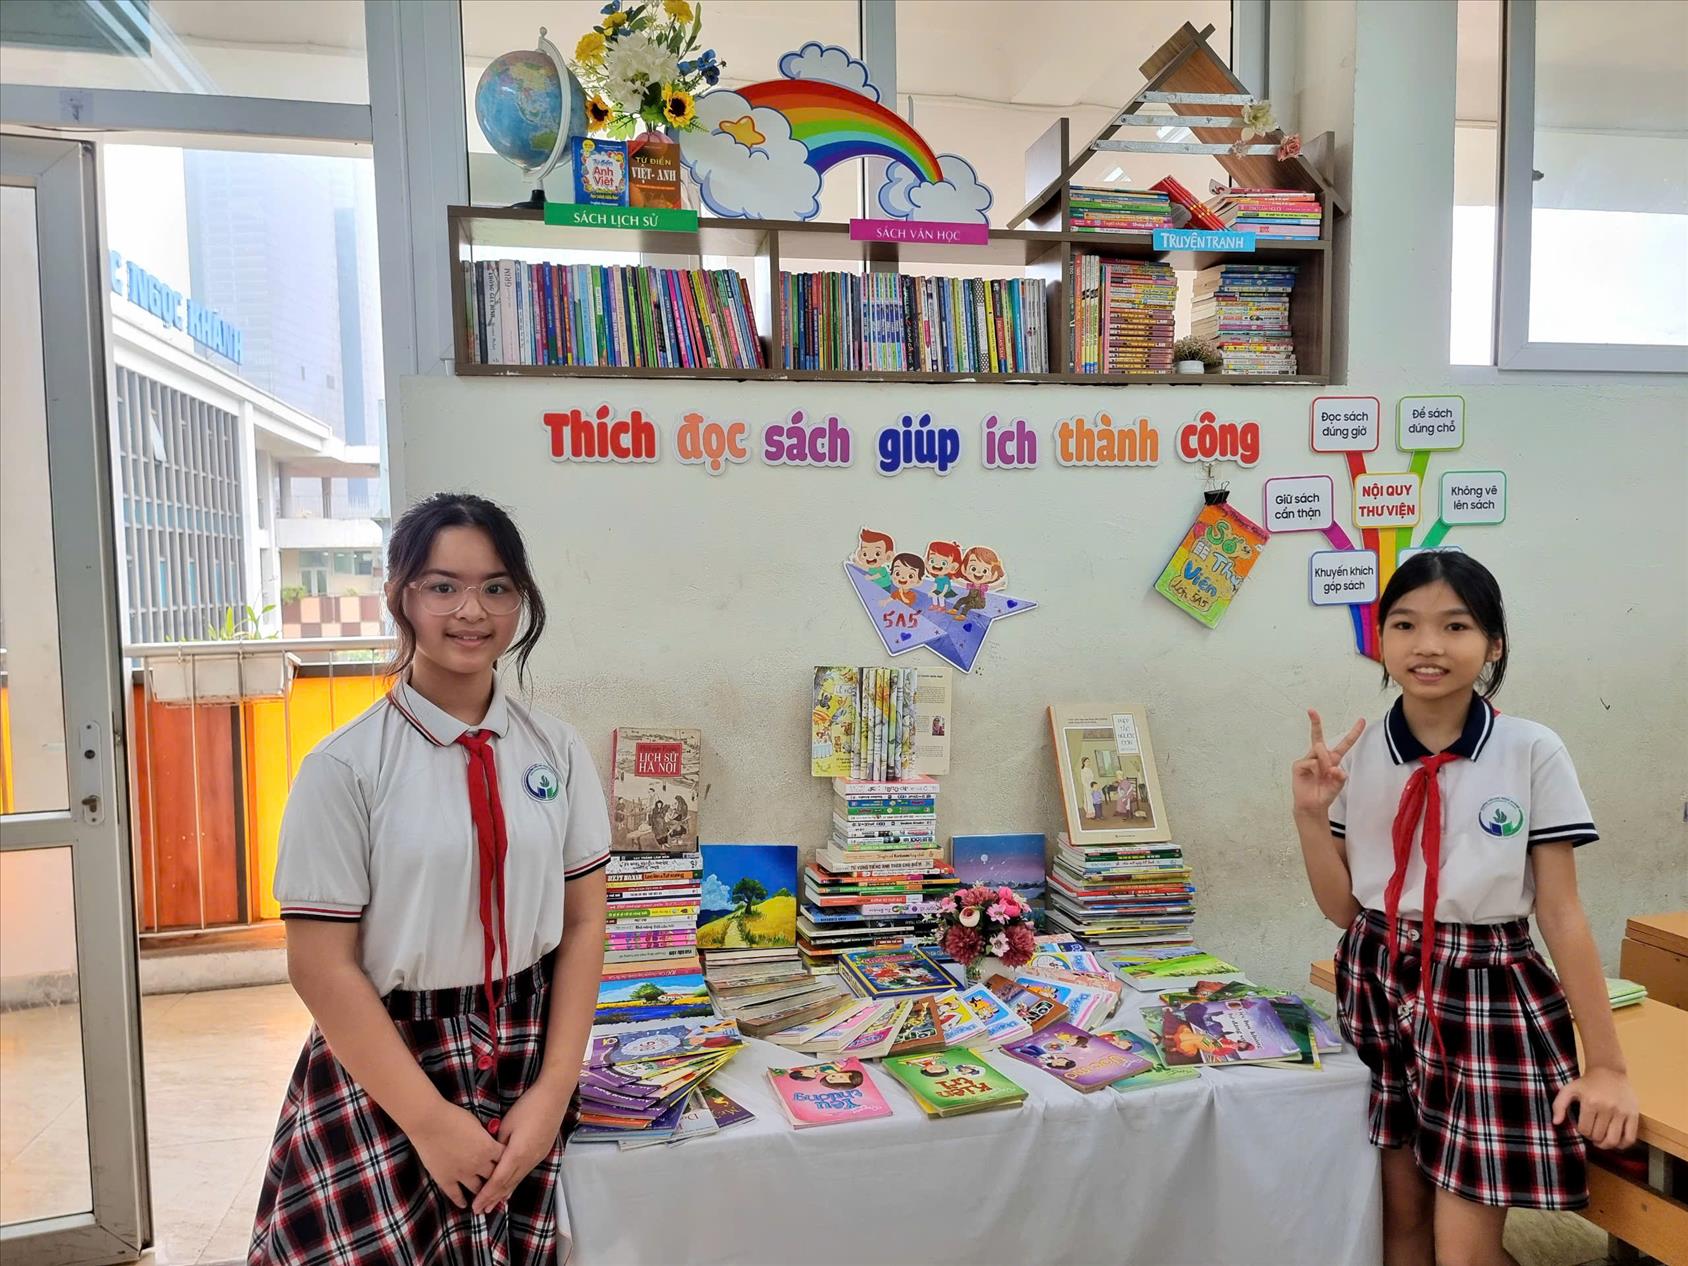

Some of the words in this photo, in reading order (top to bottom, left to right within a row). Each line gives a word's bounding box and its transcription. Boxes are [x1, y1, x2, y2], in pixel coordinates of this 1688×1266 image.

[593, 167, 614, 176] Anh
[657, 169, 676, 181] ANH
[574, 210, 607, 225] SÁCH
[611, 214, 639, 227] LỊCH
[643, 212, 659, 227] SỬ
[876, 226, 906, 239] SÁCH
[937, 230, 961, 242] HỌC
[1321, 411, 1342, 425] Đọc
[1343, 411, 1368, 422] sách
[1412, 406, 1426, 419] Để
[1427, 408, 1453, 419] sách
[1322, 424, 1349, 439] đúng
[1350, 425, 1367, 440] giờ
[1408, 422, 1435, 436] đúng
[1436, 419, 1456, 433] chỗ
[543, 404, 656, 458] Thích
[677, 413, 747, 471] đọc
[764, 410, 850, 464] sách
[878, 412, 960, 473] giúp
[985, 415, 1037, 465] ích
[1058, 413, 1159, 463] thành
[1180, 410, 1260, 464] công
[1275, 493, 1294, 505] Giữ
[1294, 492, 1320, 504] sách
[1362, 483, 1383, 500] NỘI
[1386, 484, 1412, 497] QUY
[1451, 485, 1483, 499] Không
[1274, 505, 1295, 520] cẩn
[1297, 508, 1321, 521] thận
[1359, 504, 1386, 518] THƯ
[1387, 502, 1415, 519] VIỆN
[1453, 499, 1469, 511] lên
[1469, 499, 1495, 511] sách
[1314, 563, 1349, 579] Khuyến
[1349, 564, 1374, 577] khích
[1323, 580, 1342, 594] góp
[1343, 579, 1366, 591] sách
[1191, 592, 1209, 608] 5A5
[882, 609, 923, 629] 5A5
